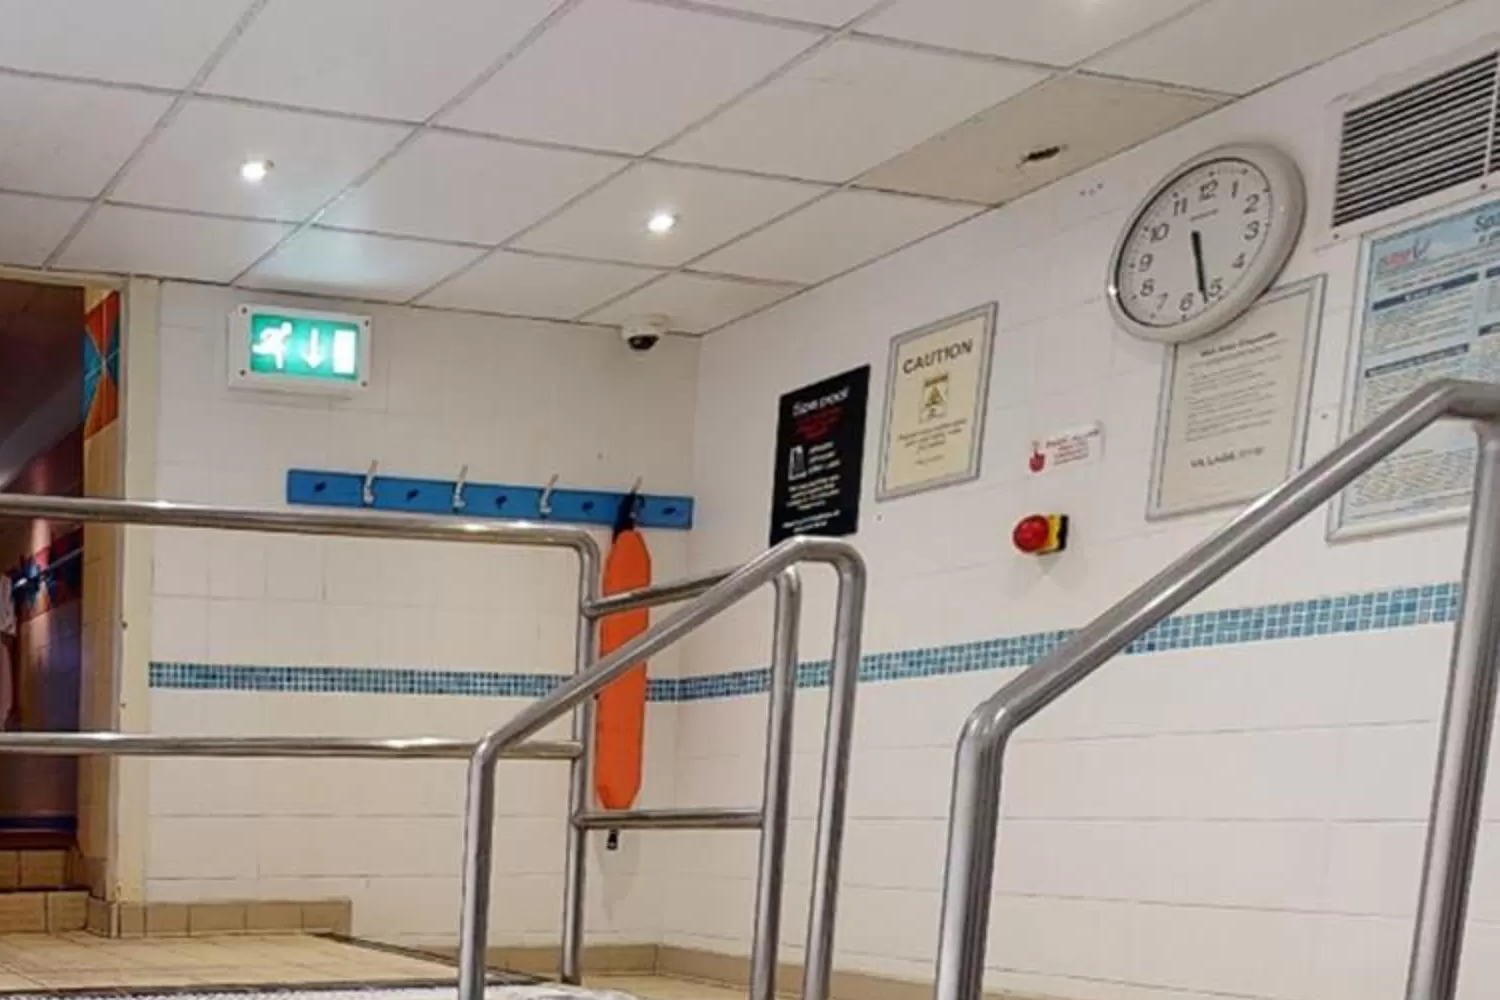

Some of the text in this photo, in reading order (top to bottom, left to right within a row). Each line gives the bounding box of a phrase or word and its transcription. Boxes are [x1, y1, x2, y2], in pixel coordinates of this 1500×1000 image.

[1199, 179, 1218, 200] 12
[1231, 180, 1239, 199] 1
[1173, 197, 1188, 216] 11
[1243, 193, 1259, 214] 2
[1151, 223, 1169, 243] 10
[1244, 220, 1259, 241] 3
[1139, 253, 1153, 272] 9
[1232, 252, 1245, 269] 4
[1140, 278, 1154, 298] 8
[1208, 277, 1223, 298] 5
[1157, 293, 1168, 311] 7
[1179, 292, 1194, 312] 6
[903, 338, 973, 374] CAUTION
